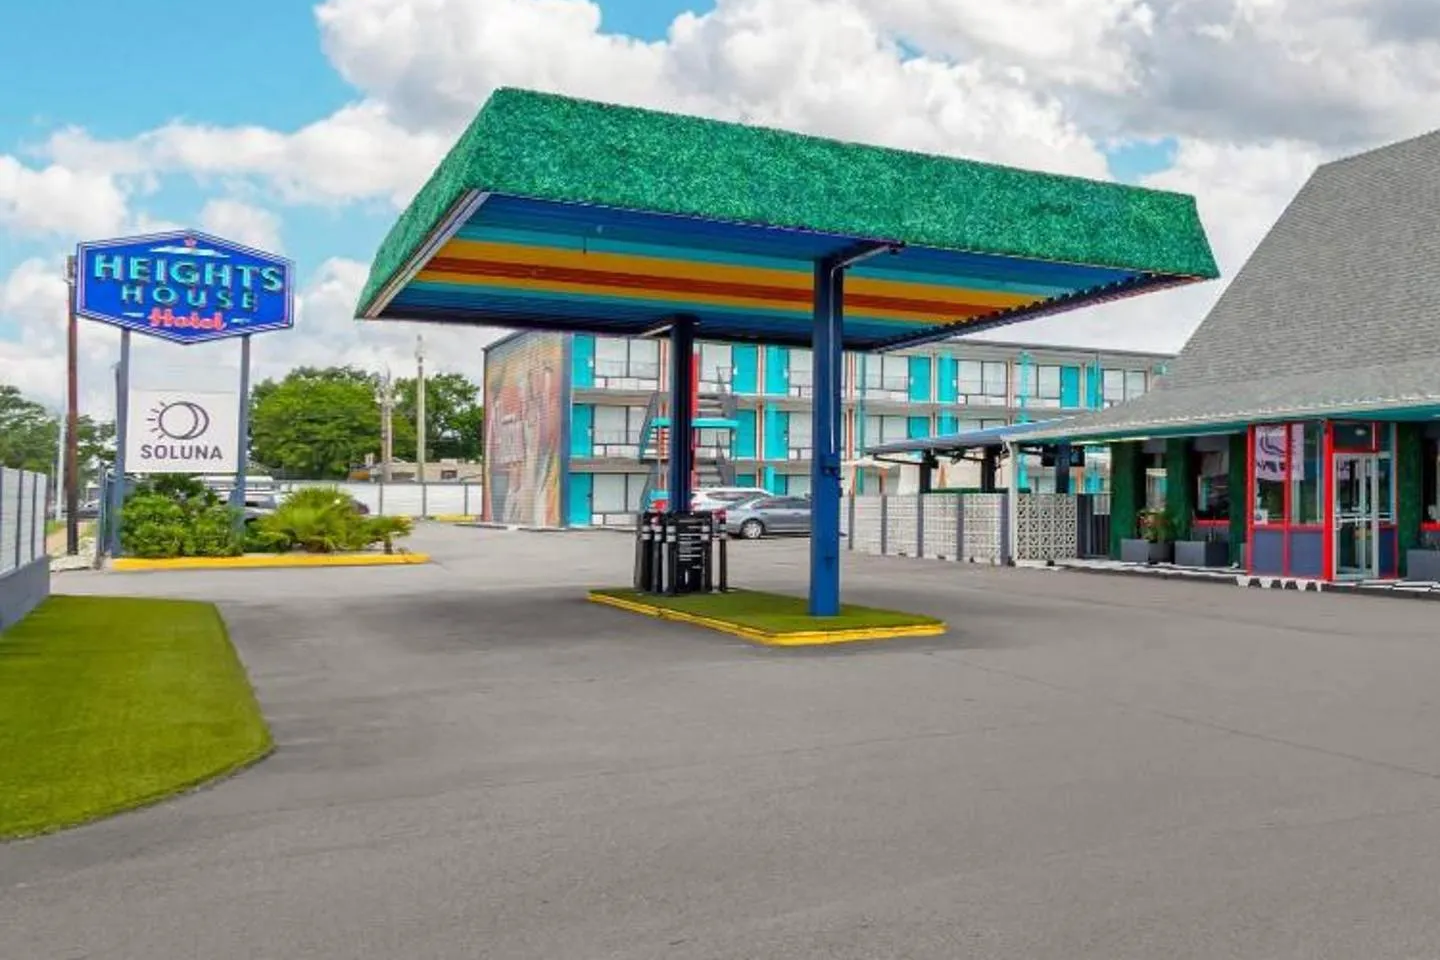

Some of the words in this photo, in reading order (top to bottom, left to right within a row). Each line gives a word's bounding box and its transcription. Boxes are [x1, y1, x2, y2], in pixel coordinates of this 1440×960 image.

[94, 254, 284, 291] HEIGHTS
[121, 284, 257, 310] HOUSE
[147, 307, 227, 329] Hotel
[140, 444, 223, 460] SOLUNA
